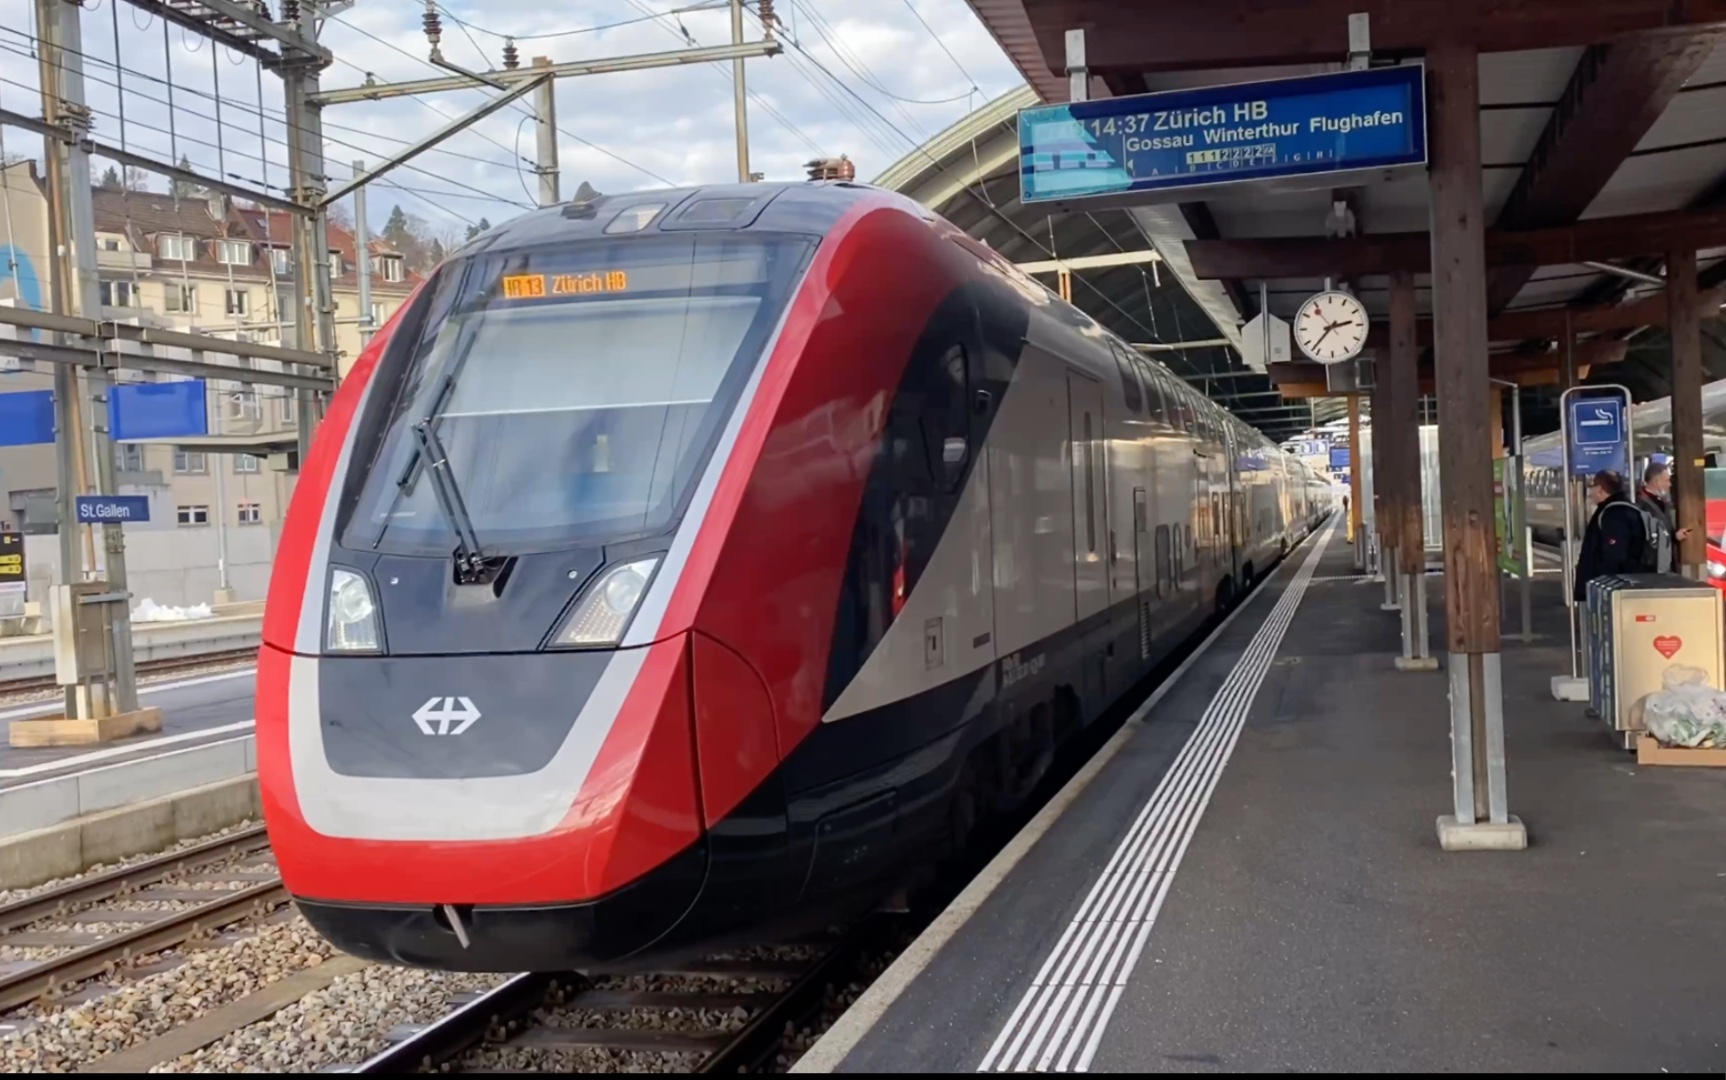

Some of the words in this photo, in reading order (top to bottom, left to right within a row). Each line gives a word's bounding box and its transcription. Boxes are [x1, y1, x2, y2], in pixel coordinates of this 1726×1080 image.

[1091, 113, 1150, 137] 14:37
[1153, 106, 1226, 131] Zürich
[1234, 101, 1268, 122] HB
[1126, 134, 1194, 151] Gossau
[1203, 122, 1300, 144] Winterthur
[1309, 110, 1403, 133] Flughafen
[507, 279, 522, 296] IR
[527, 277, 543, 295] 13
[551, 273, 603, 294] Zürich
[606, 271, 626, 291] HB
